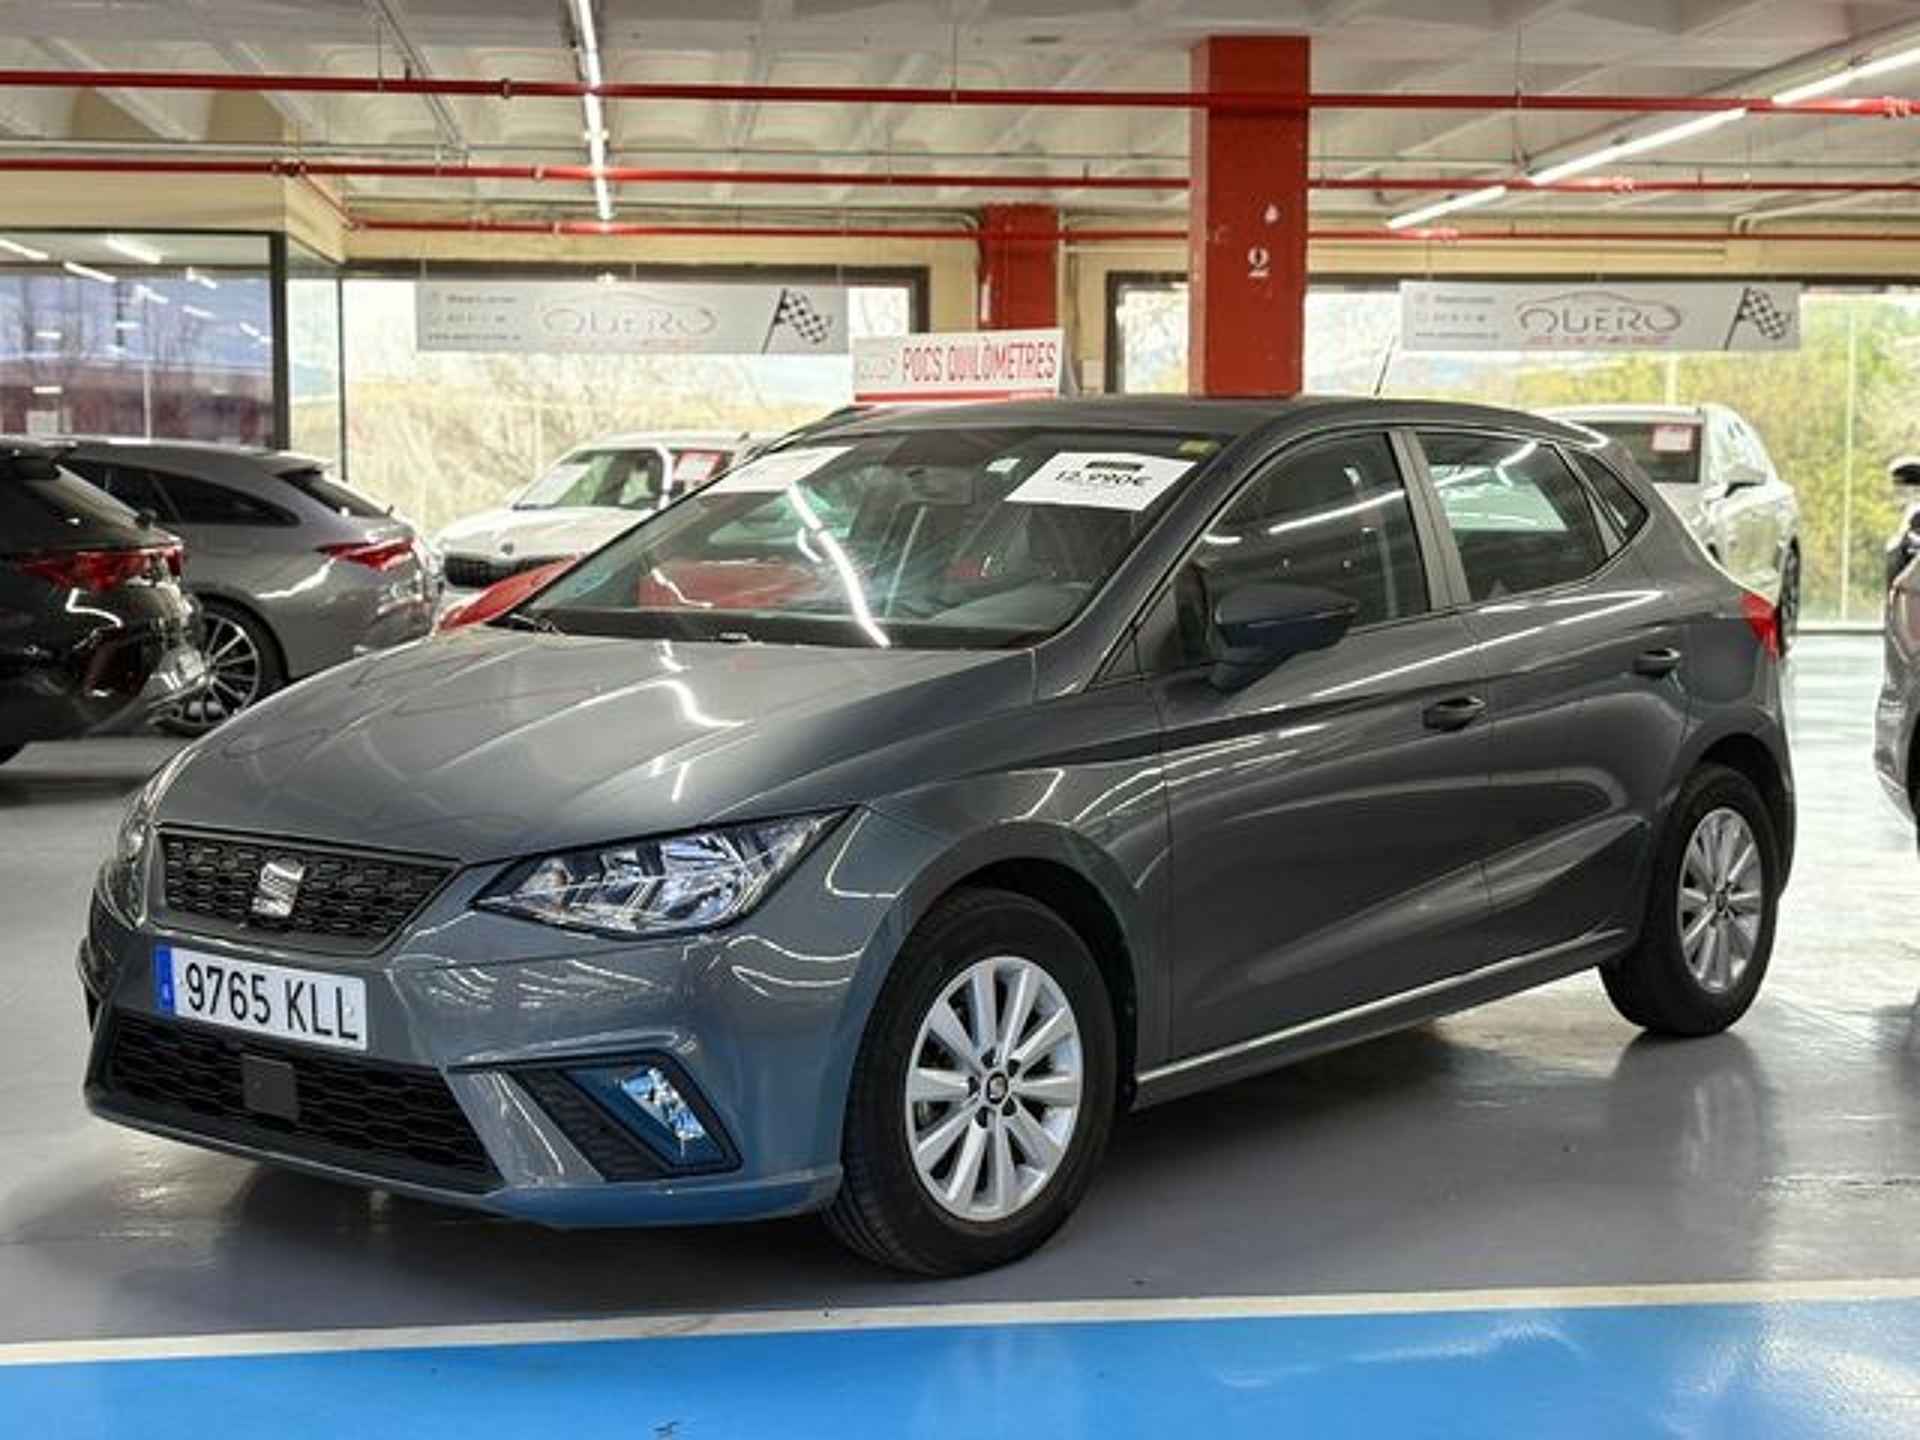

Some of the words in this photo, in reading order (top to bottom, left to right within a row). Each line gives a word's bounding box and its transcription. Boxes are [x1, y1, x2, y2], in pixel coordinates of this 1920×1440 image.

[1520, 304, 1681, 334] QUERO
[902, 346, 943, 382] POCS
[185, 962, 271, 1024] 9765
[285, 979, 358, 1041] KLL
